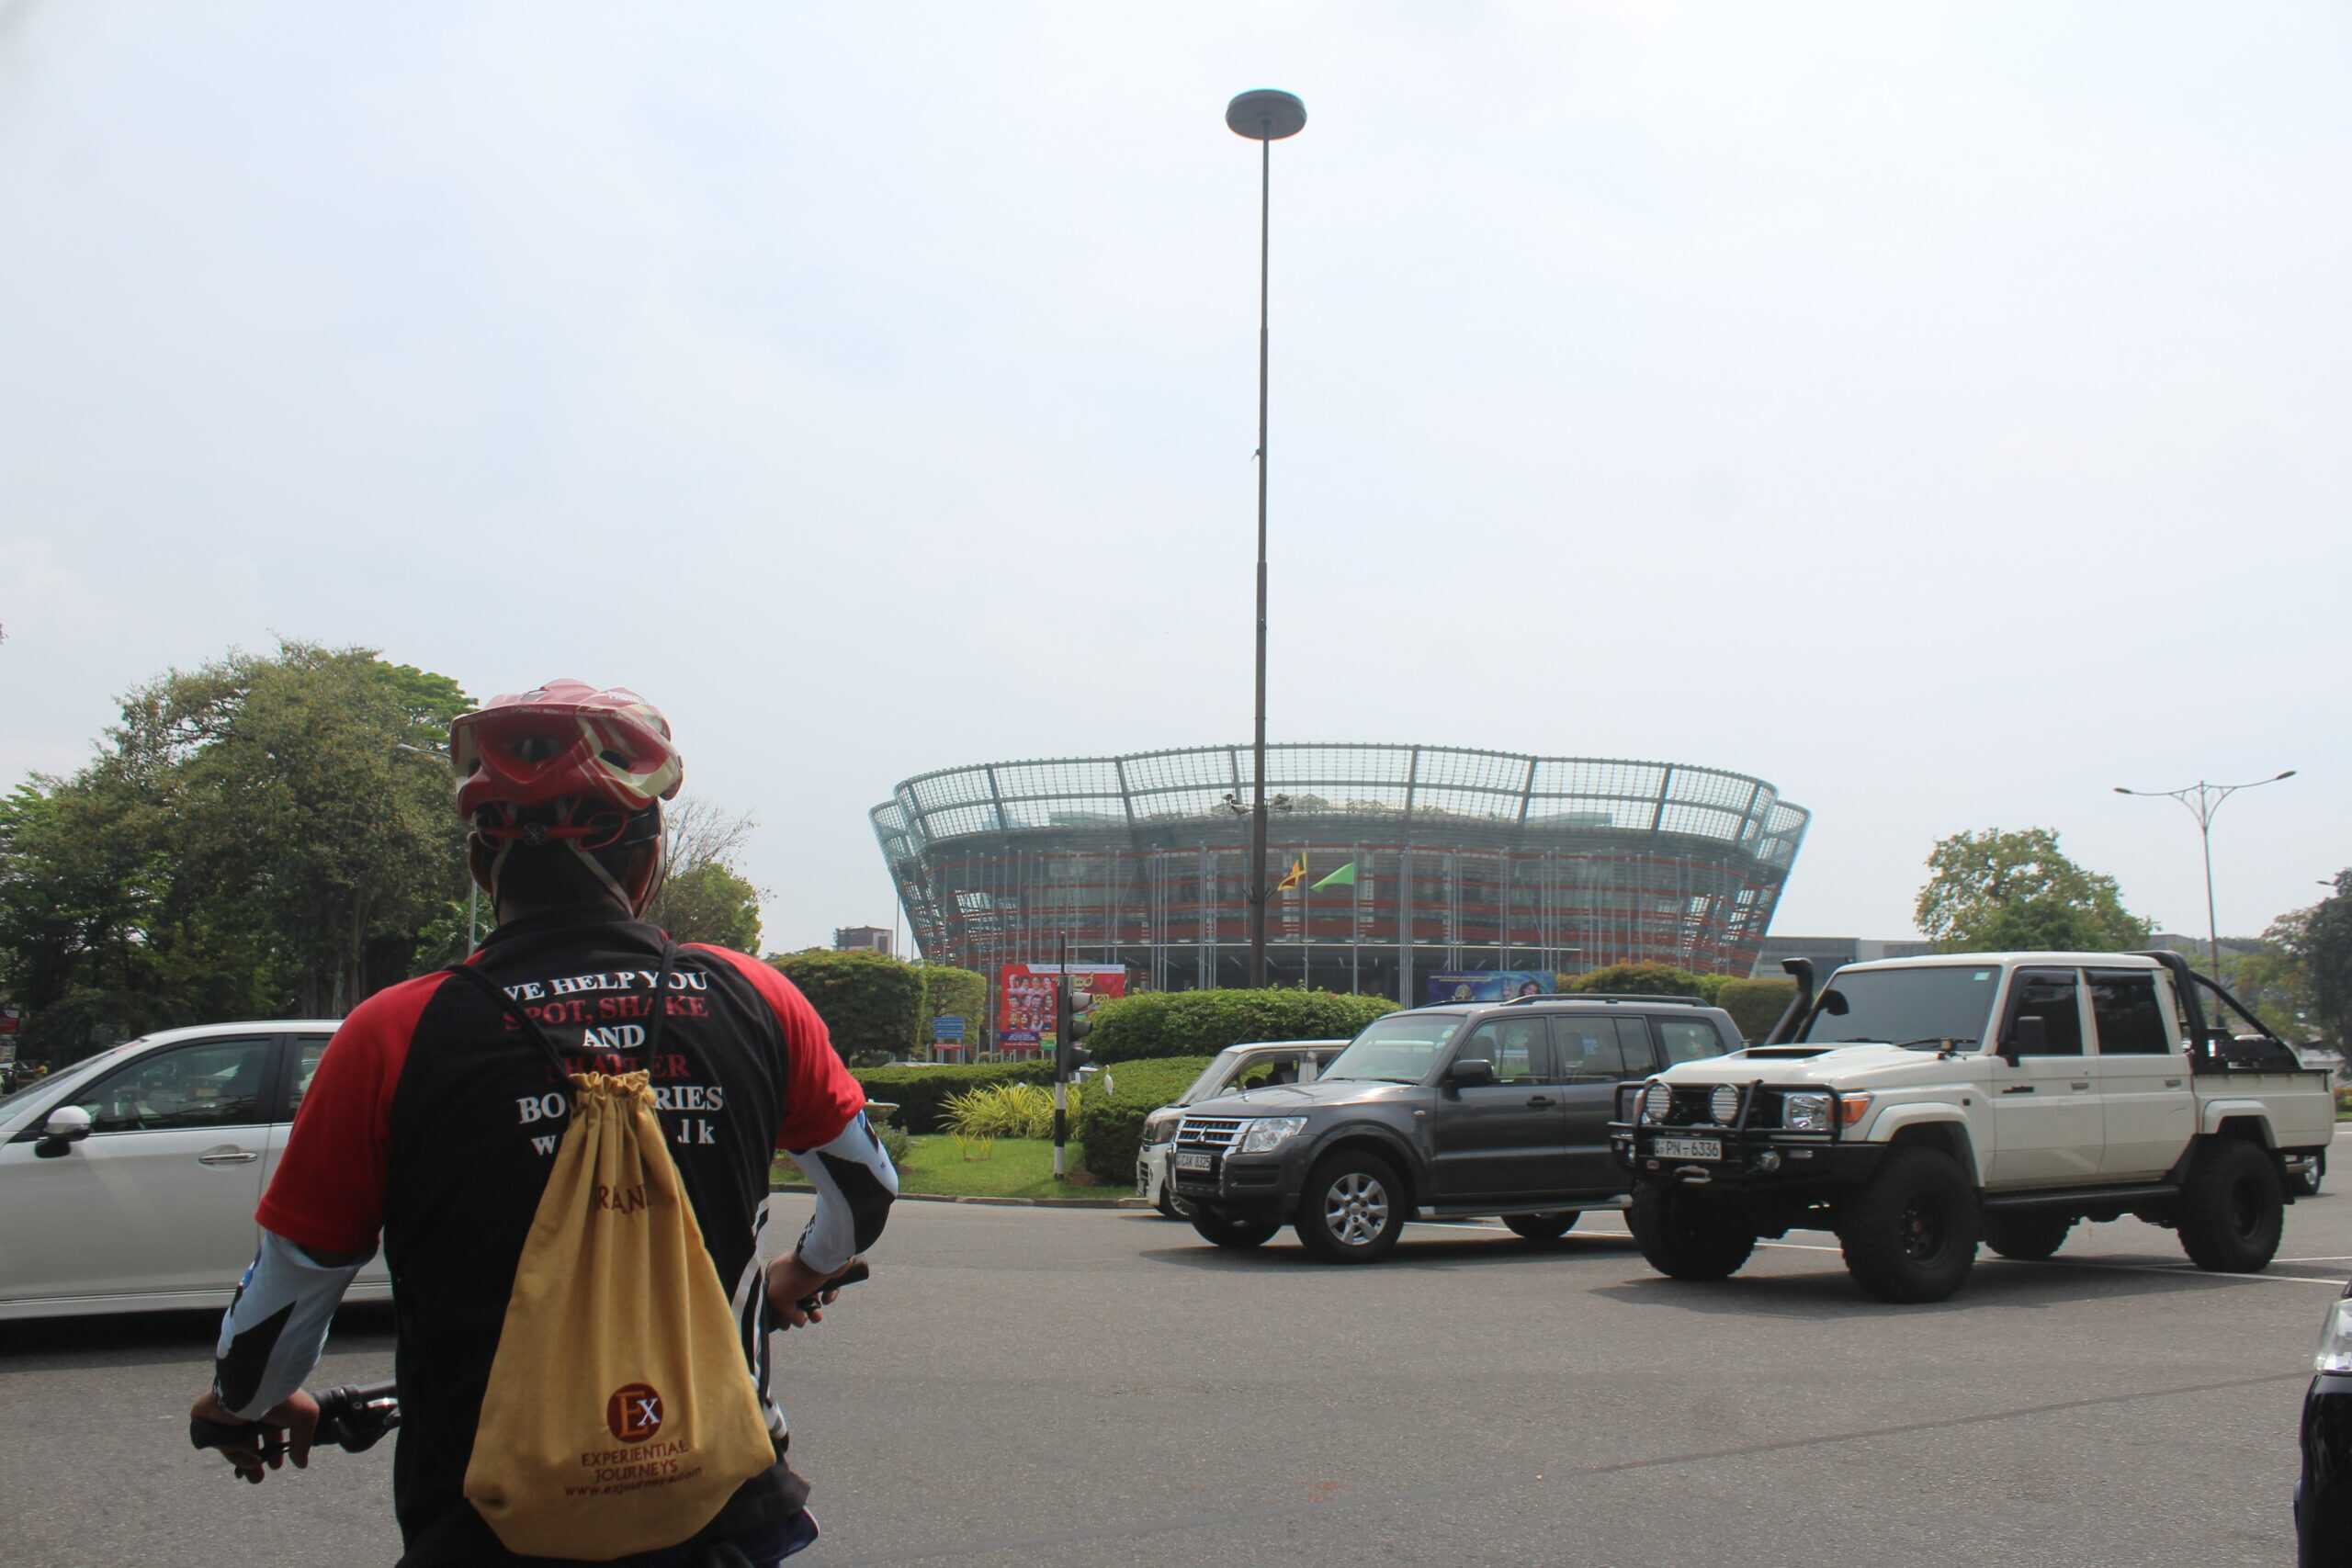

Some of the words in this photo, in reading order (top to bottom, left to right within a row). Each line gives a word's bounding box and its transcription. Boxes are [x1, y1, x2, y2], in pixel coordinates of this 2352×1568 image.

[551, 971, 636, 996] HELP
[638, 970, 707, 990] YOU
[582, 1024, 645, 1049] AND
[581, 1439, 689, 1468] EXPERIENTIAL
[595, 1459, 679, 1483] JOURNEYS
